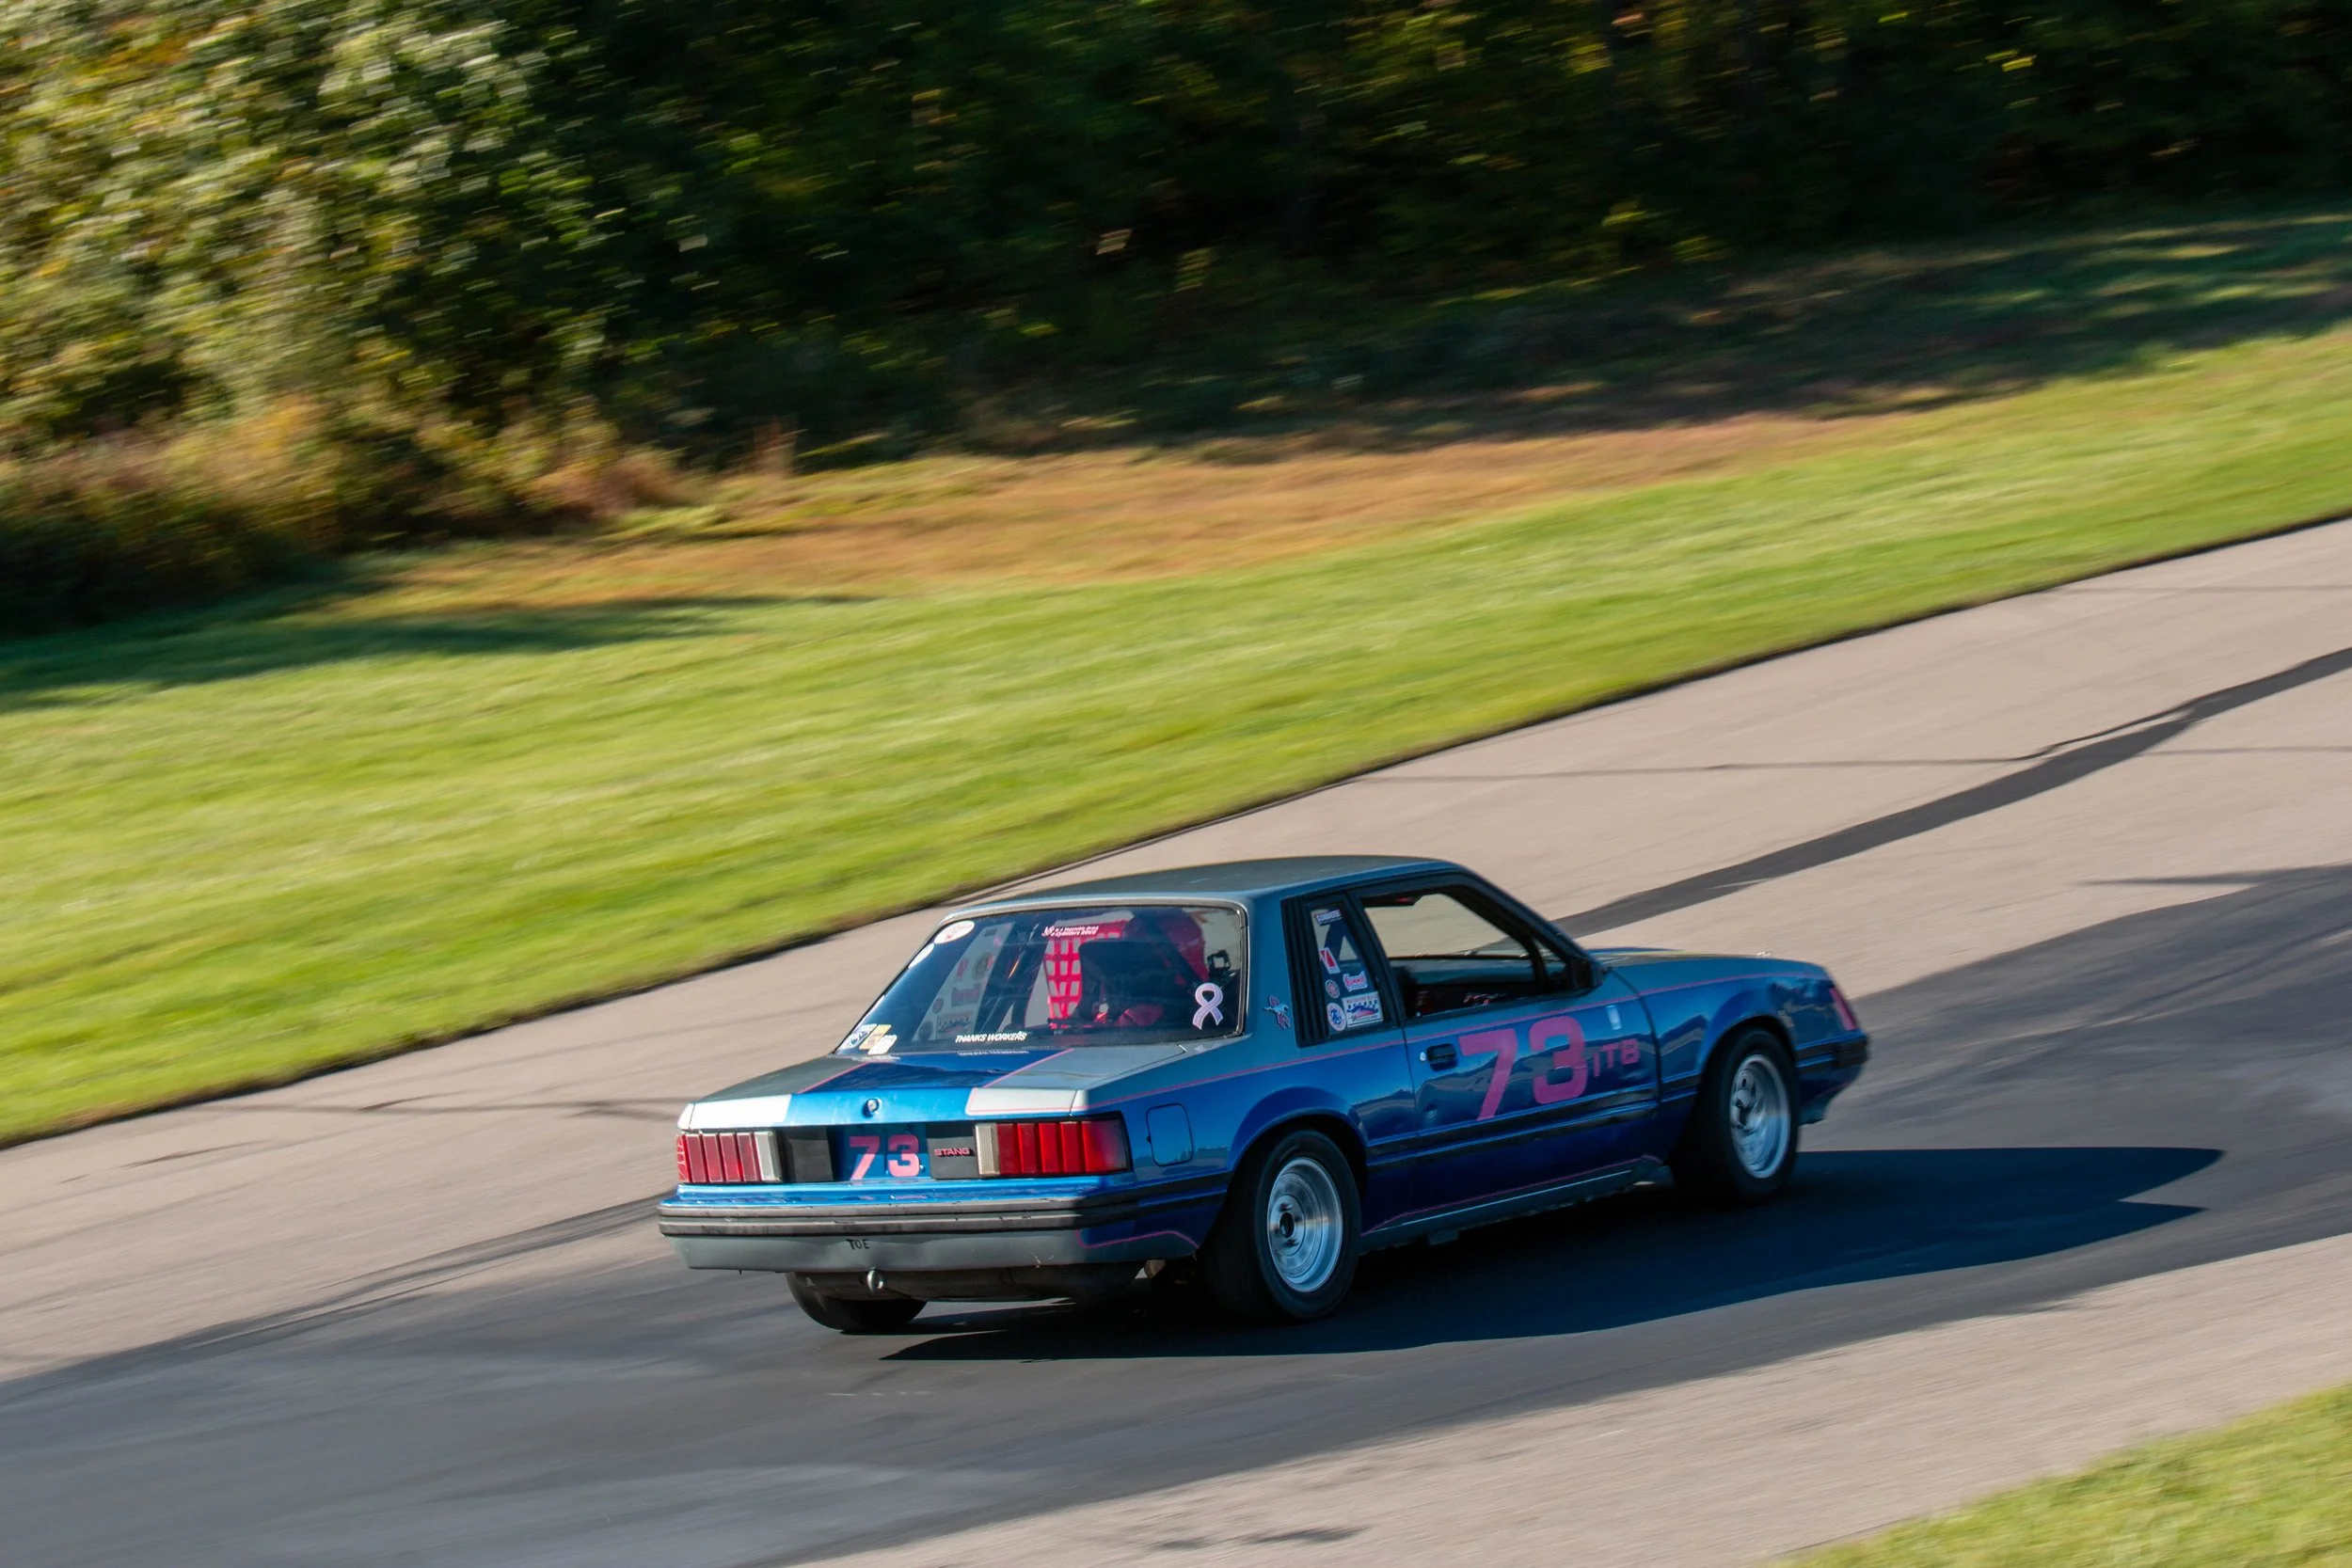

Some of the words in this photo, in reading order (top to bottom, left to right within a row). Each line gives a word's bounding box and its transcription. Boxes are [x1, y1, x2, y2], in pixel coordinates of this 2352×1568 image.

[955, 1034, 987, 1043] THANKS
[987, 1031, 1027, 1042] WORKERS
[1458, 1016, 1588, 1121] 73
[1593, 1038, 1641, 1078] ITB
[850, 1134, 919, 1180] 73
[934, 1148, 970, 1156] STANG
[846, 1239, 870, 1250] TOE
